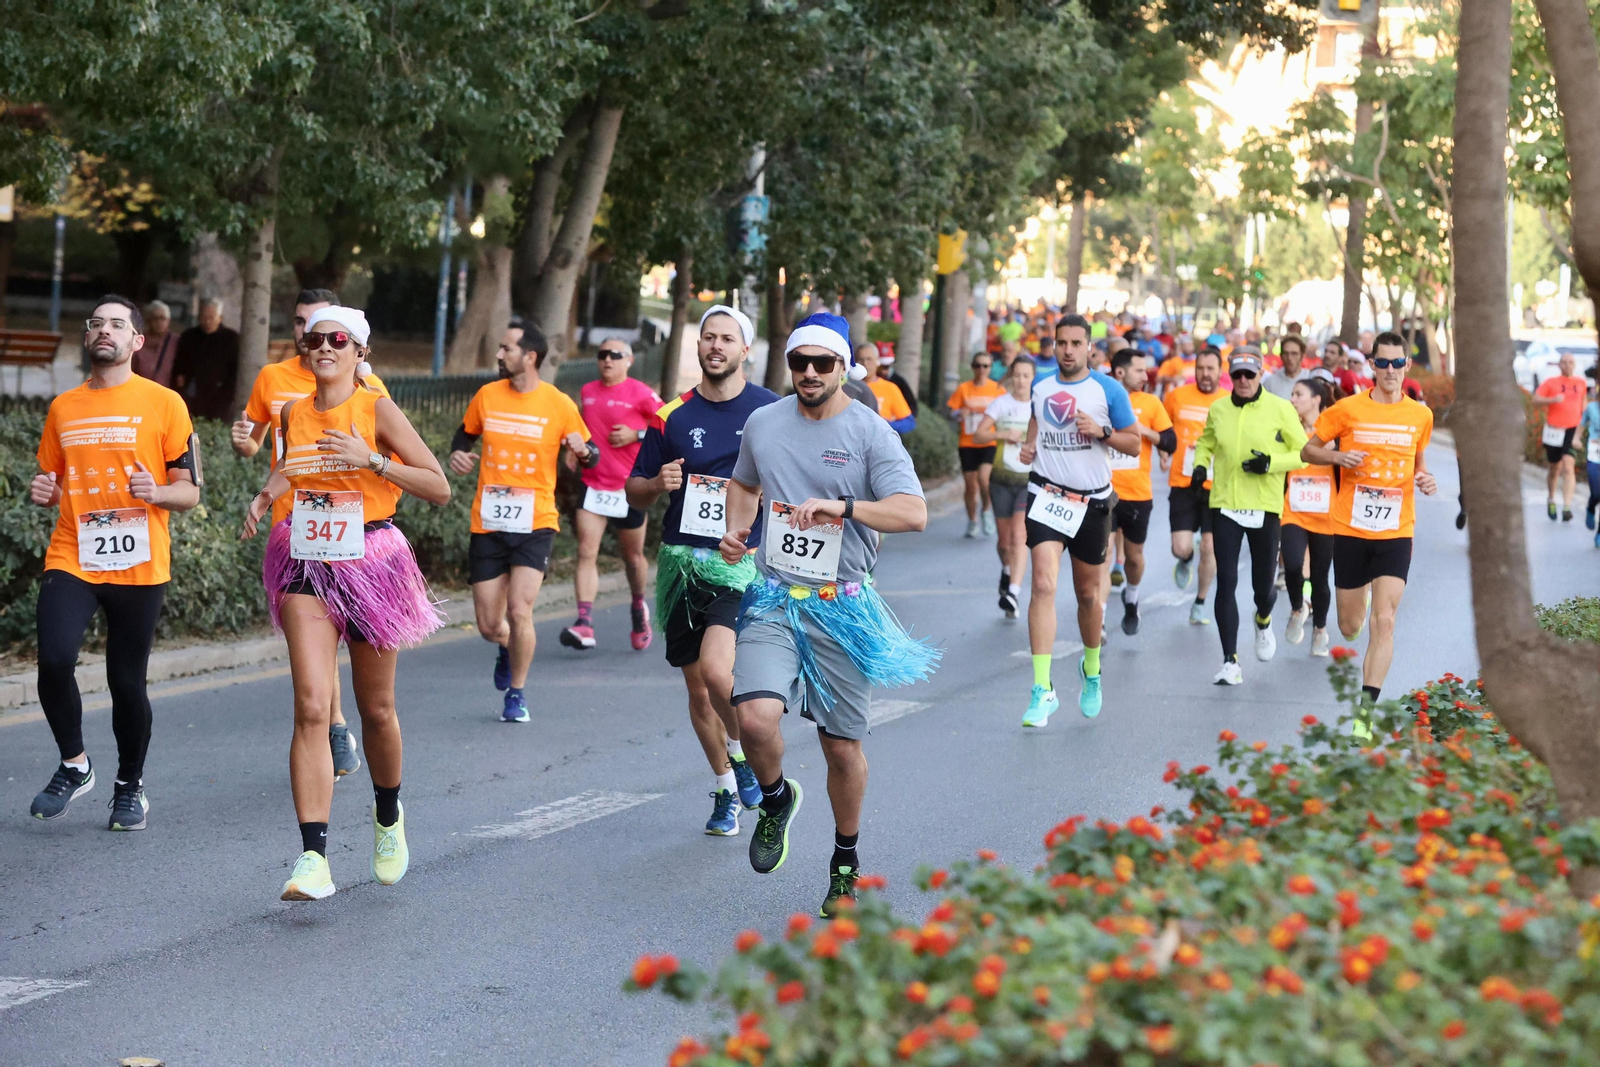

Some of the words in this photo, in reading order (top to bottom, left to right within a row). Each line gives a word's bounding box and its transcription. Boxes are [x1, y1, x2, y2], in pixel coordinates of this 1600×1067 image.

[76, 438, 100, 446] PALMA
[297, 467, 321, 476] PALMA
[595, 493, 620, 507] 527
[1298, 490, 1323, 503] 358
[493, 505, 523, 520] 327
[1044, 502, 1074, 522] 480
[1363, 504, 1393, 520] 577
[305, 519, 348, 542] 347
[94, 534, 136, 555] 210
[781, 533, 825, 560] 837
